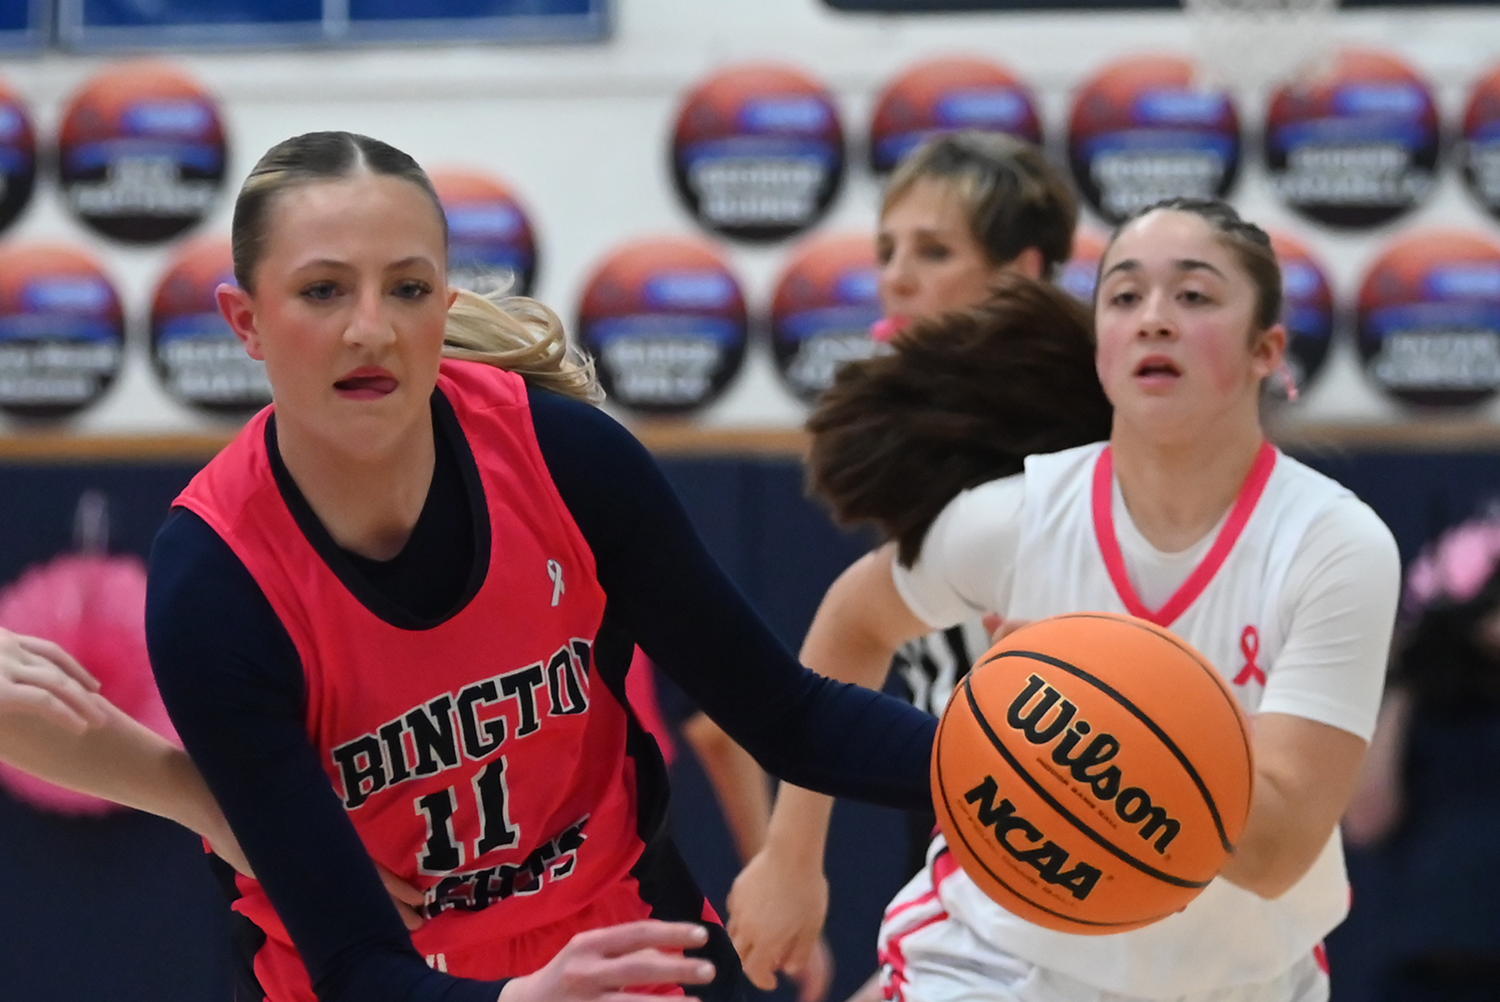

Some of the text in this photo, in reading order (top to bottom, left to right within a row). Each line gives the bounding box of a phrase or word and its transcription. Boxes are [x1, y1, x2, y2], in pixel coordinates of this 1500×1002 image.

[331, 637, 593, 811] BINGTO
[1006, 672, 1181, 855] Wilson
[413, 754, 521, 877] 11
[964, 774, 1103, 901] NCAA
